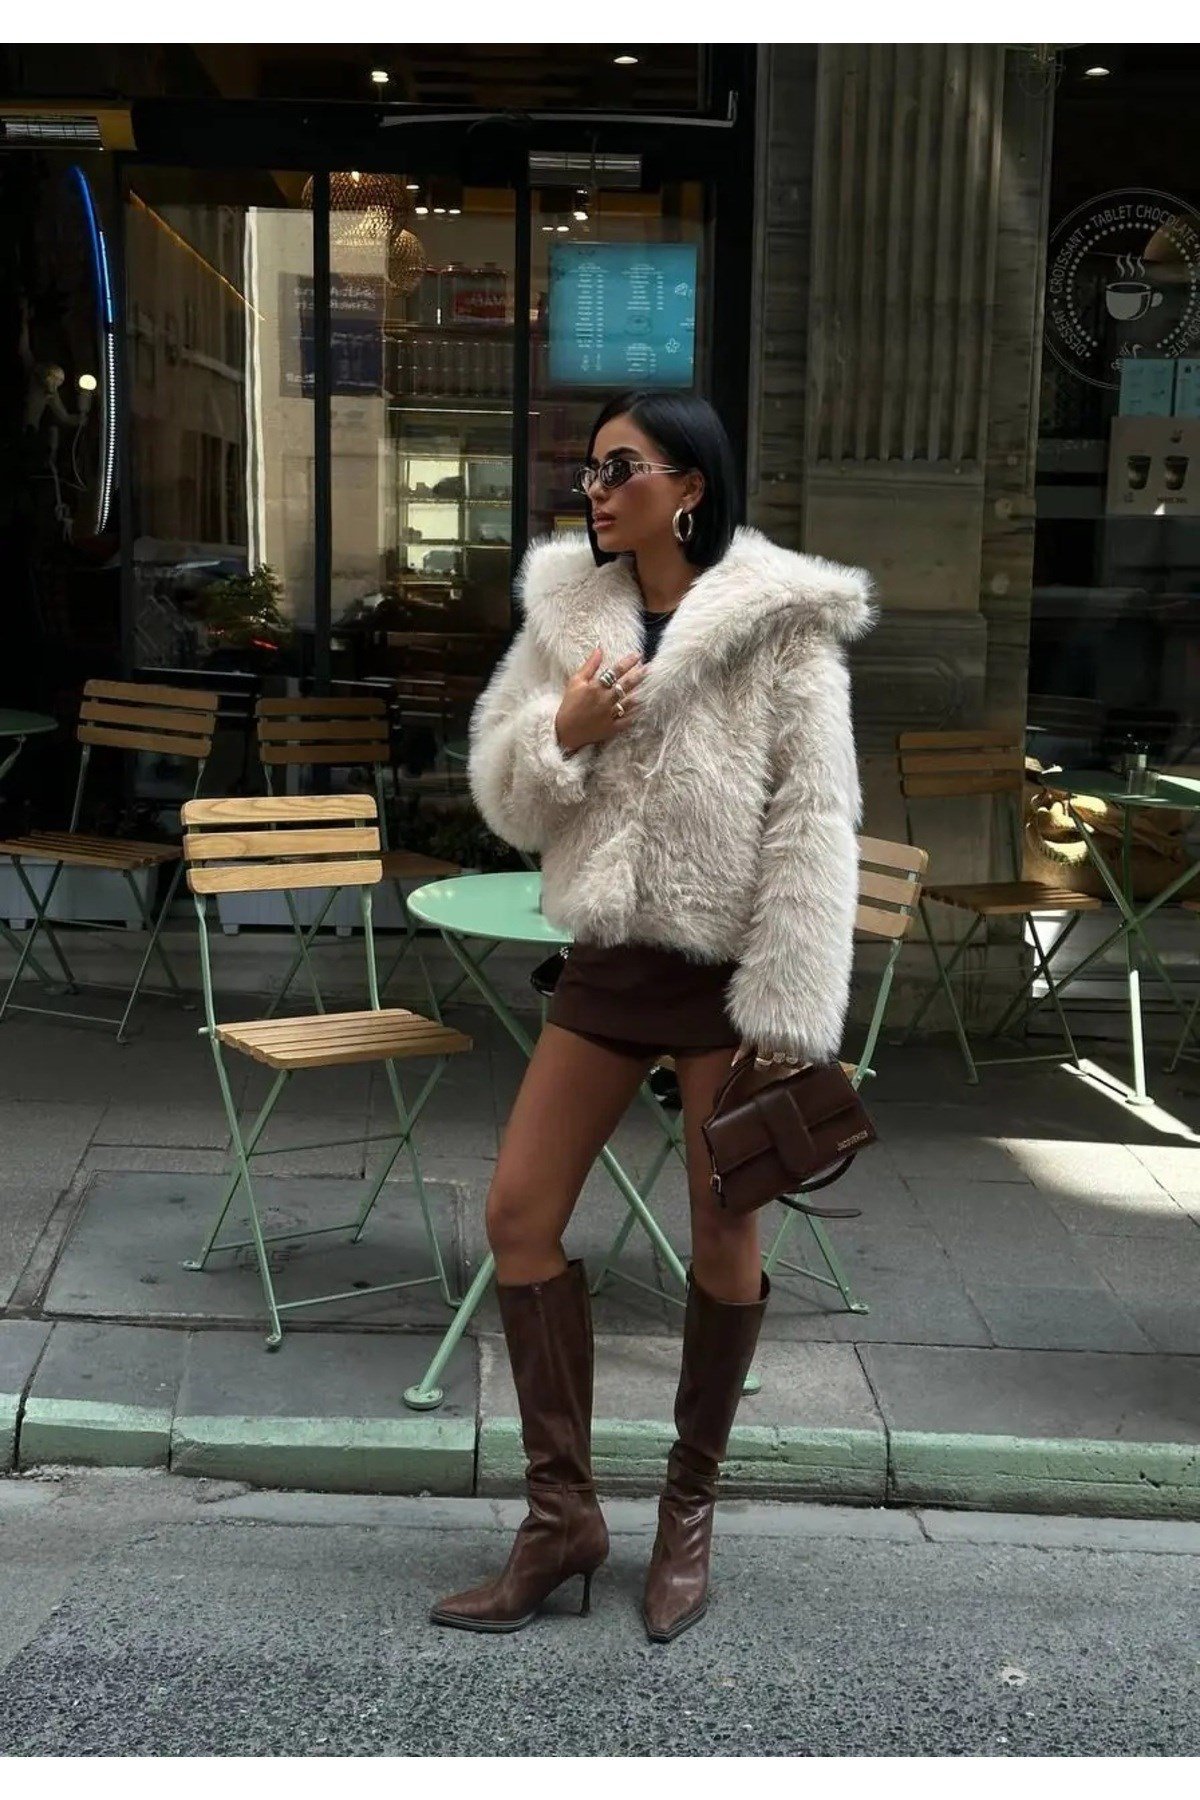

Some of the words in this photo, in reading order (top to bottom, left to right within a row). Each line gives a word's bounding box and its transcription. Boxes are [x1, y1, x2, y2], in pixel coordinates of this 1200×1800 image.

[1091, 204, 1133, 227] TABLET
[1136, 204, 1198, 245] CHOCOLATE
[1049, 228, 1086, 294] CROISSANT
[1051, 310, 1087, 356] DESSERT
